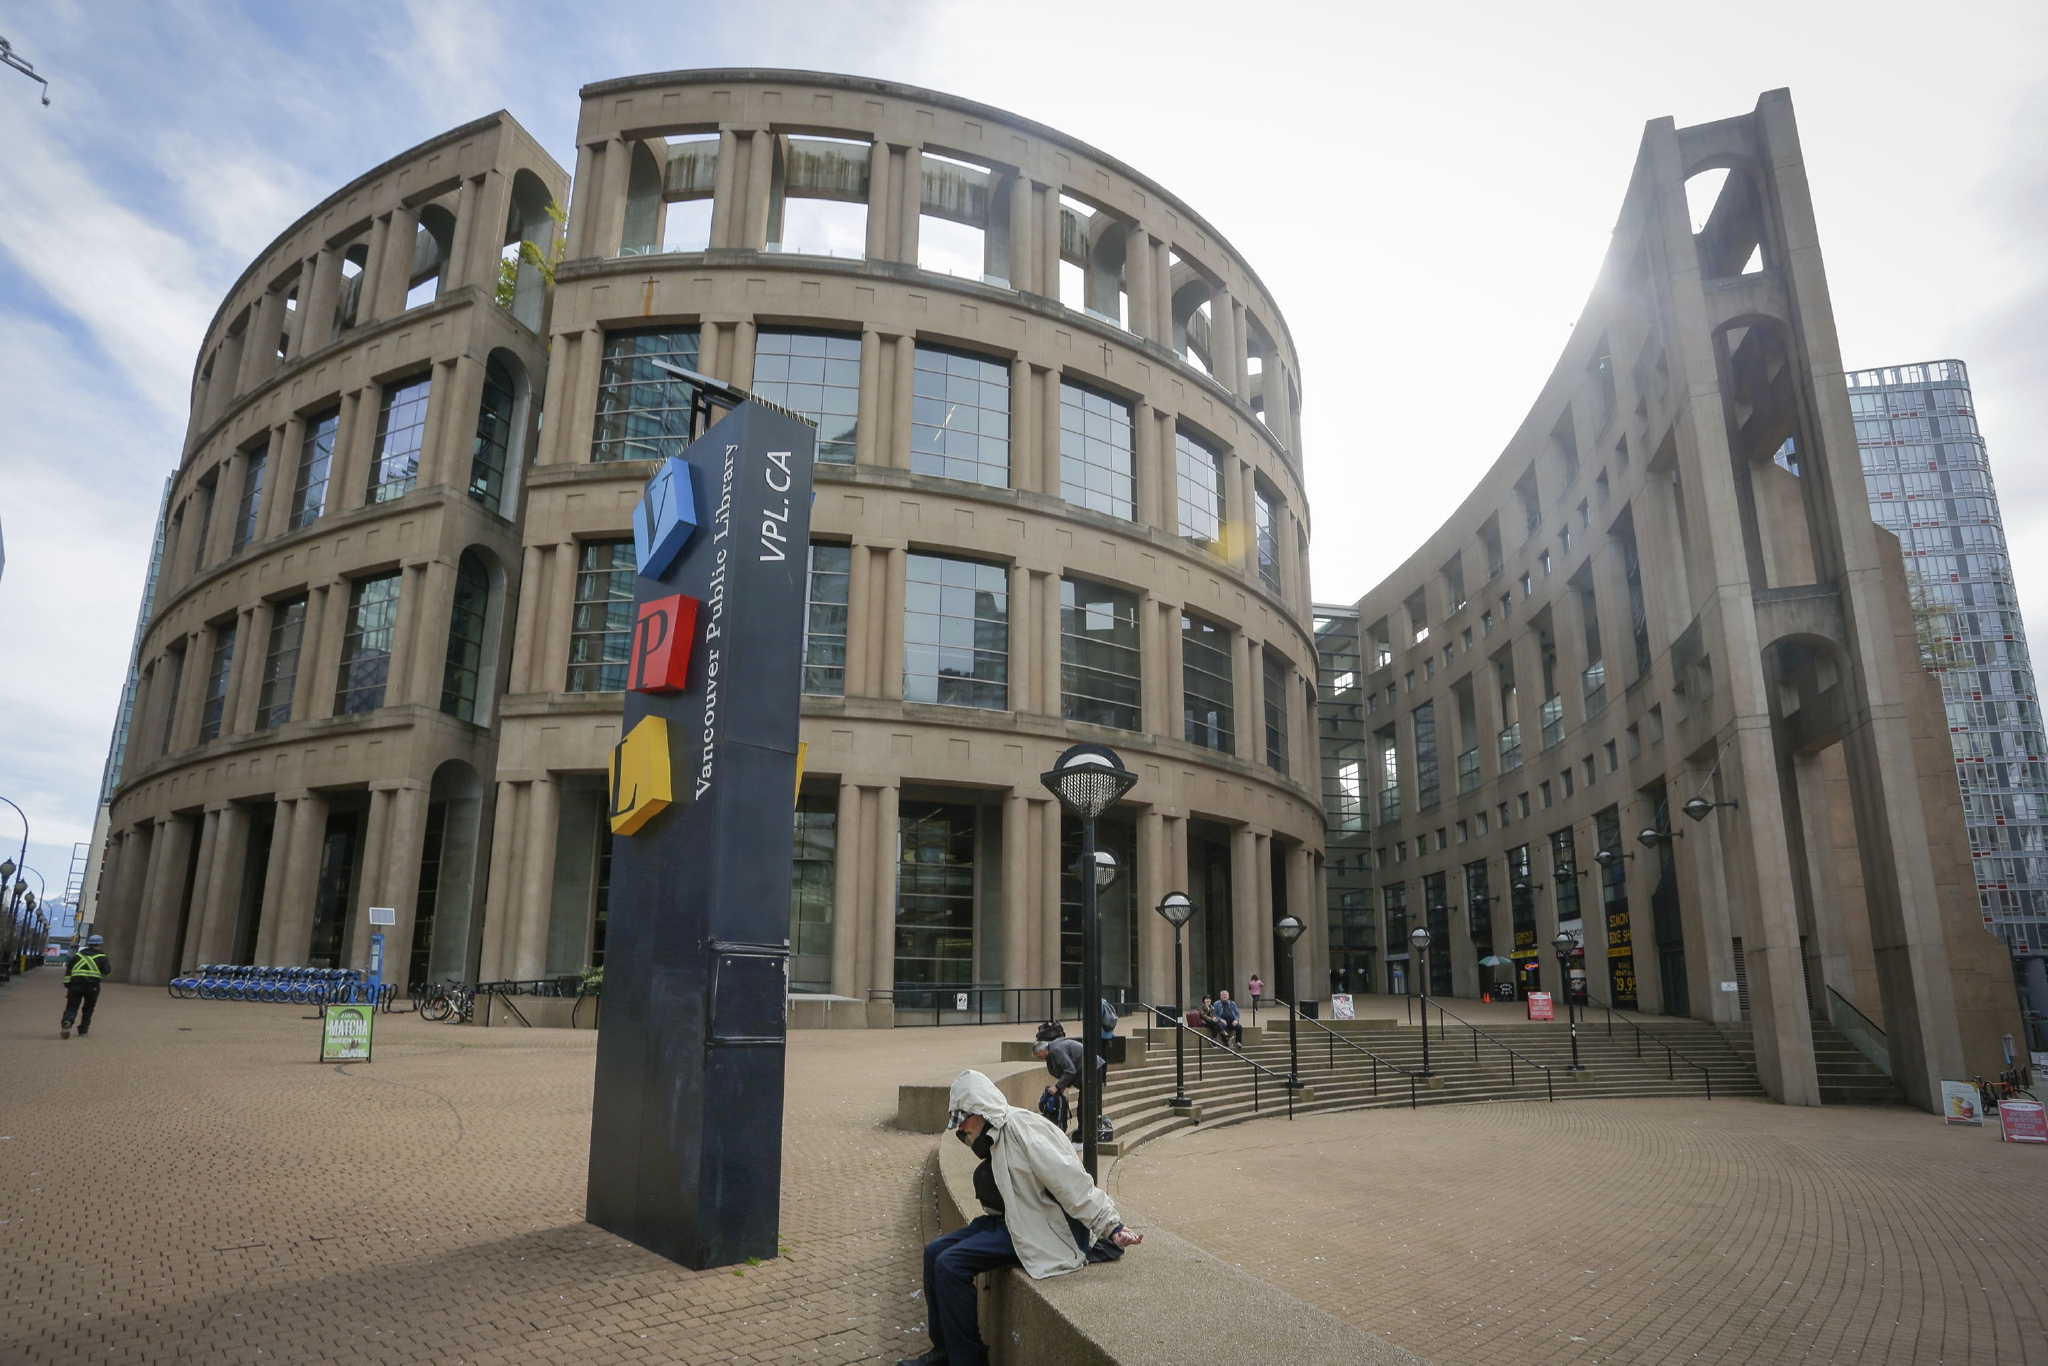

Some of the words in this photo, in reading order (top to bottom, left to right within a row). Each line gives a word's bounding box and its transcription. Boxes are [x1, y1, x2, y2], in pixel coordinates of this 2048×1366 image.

[647, 475, 673, 554] V
[714, 443, 740, 545] Library
[760, 452, 791, 561] VPL.CA
[706, 548, 726, 643] Public
[635, 609, 668, 690] P
[695, 650, 721, 800] Vancouver
[610, 738, 637, 818] L
[328, 1020, 368, 1036] MATCHA
